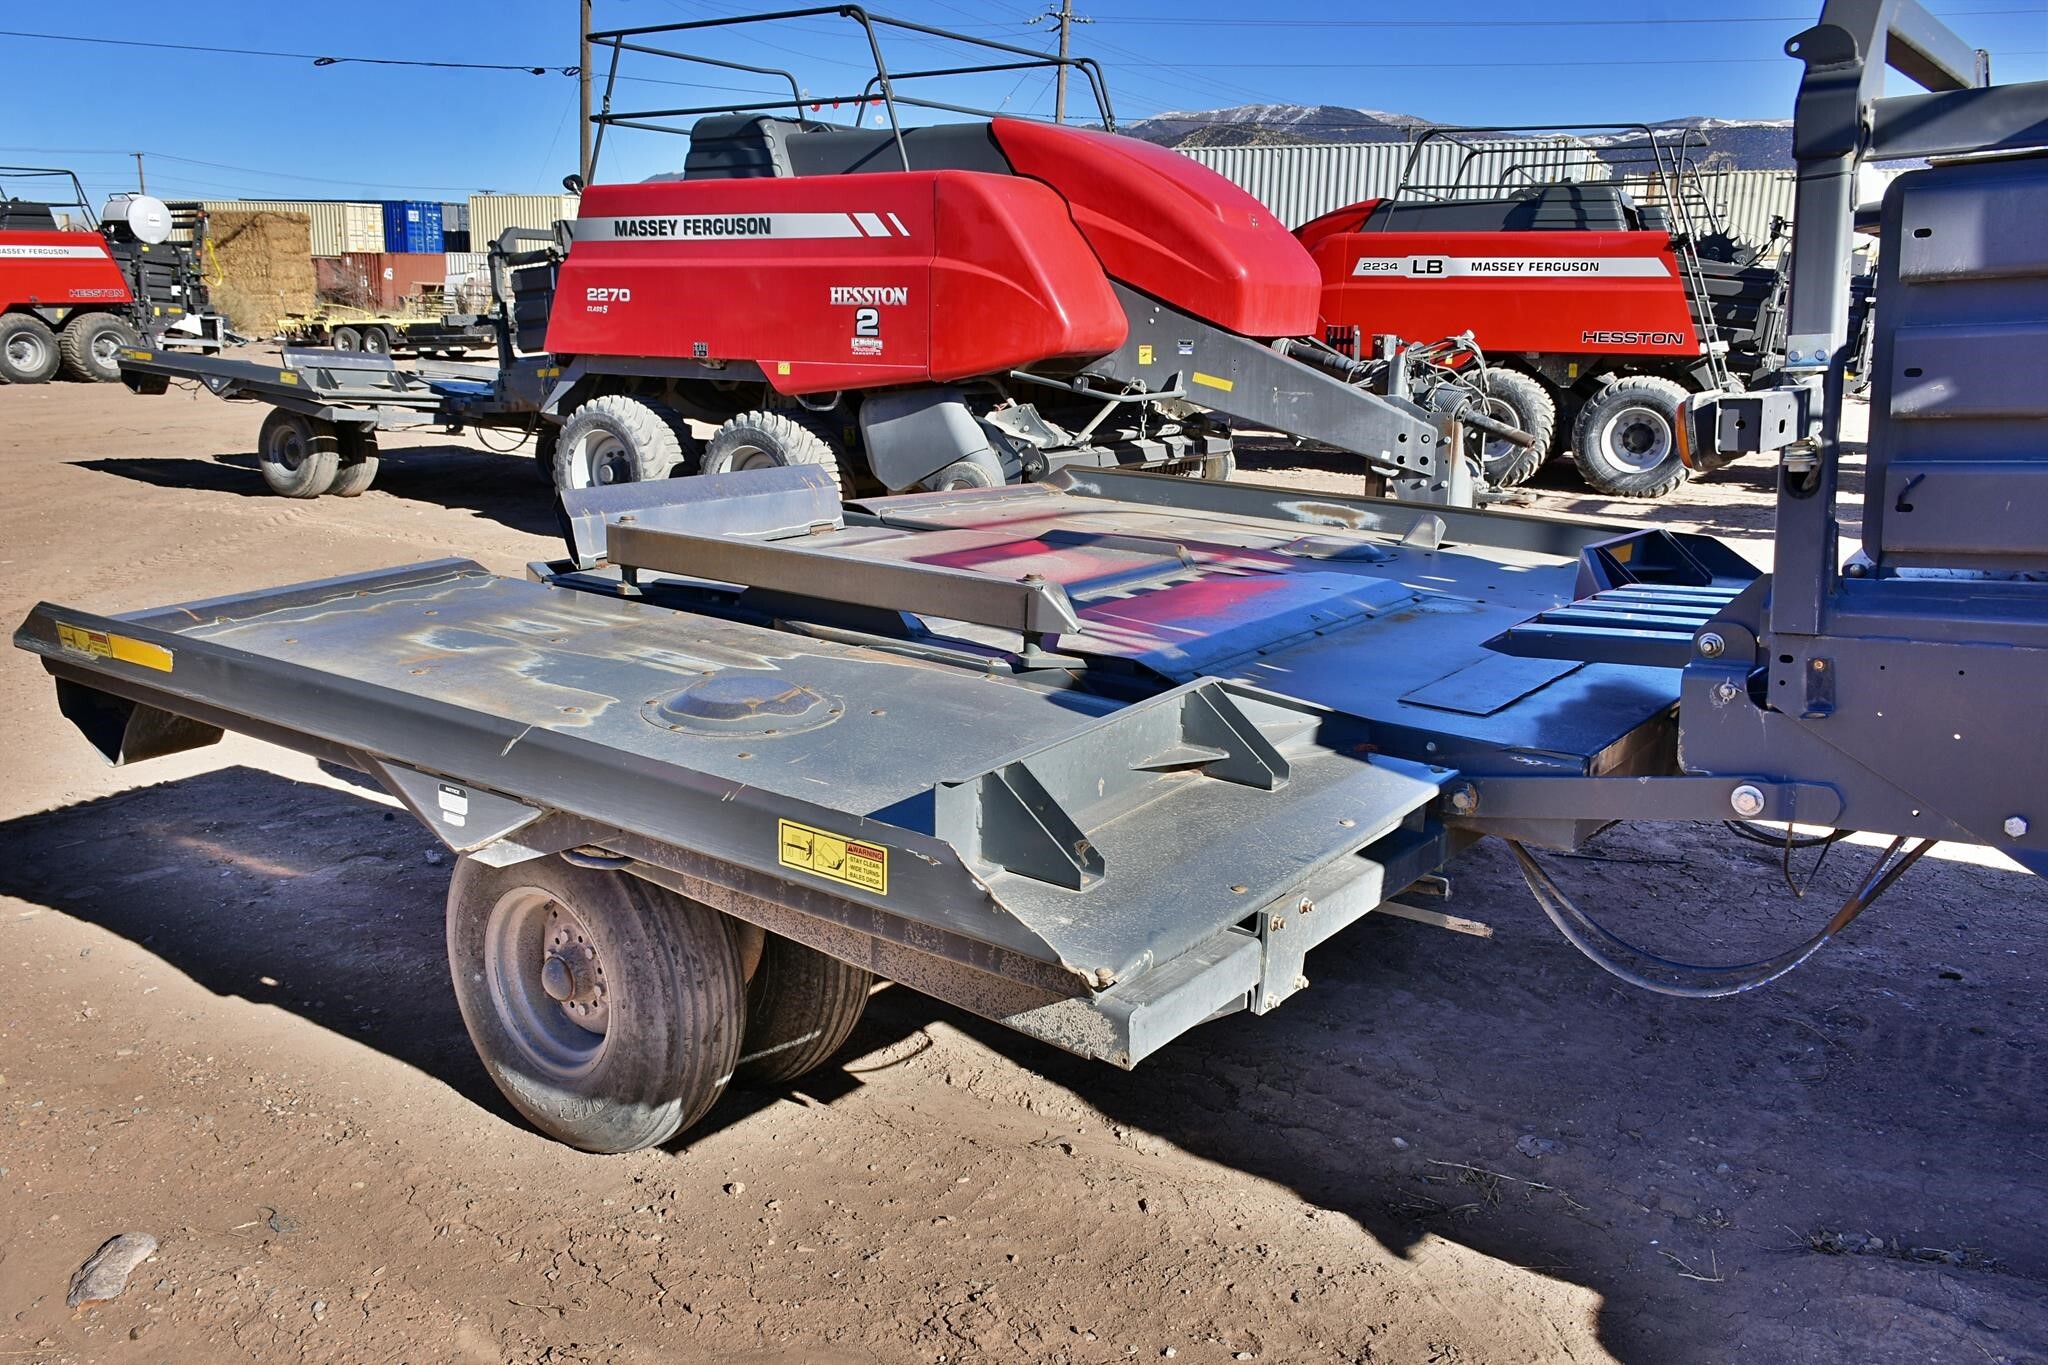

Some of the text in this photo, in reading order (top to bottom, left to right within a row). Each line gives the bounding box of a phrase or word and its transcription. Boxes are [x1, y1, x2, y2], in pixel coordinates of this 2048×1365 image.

[614, 217, 772, 237] MASSEY FERGUSON
[1362, 259, 1600, 274] 2234 LB MASSEY FERGUSON
[69, 288, 124, 298] HESSTON
[586, 287, 631, 302] 2270
[829, 286, 908, 306] HESSTON
[855, 307, 879, 337] 2
[1581, 330, 1685, 346] HESSTON
[852, 846, 882, 860] WARNING
